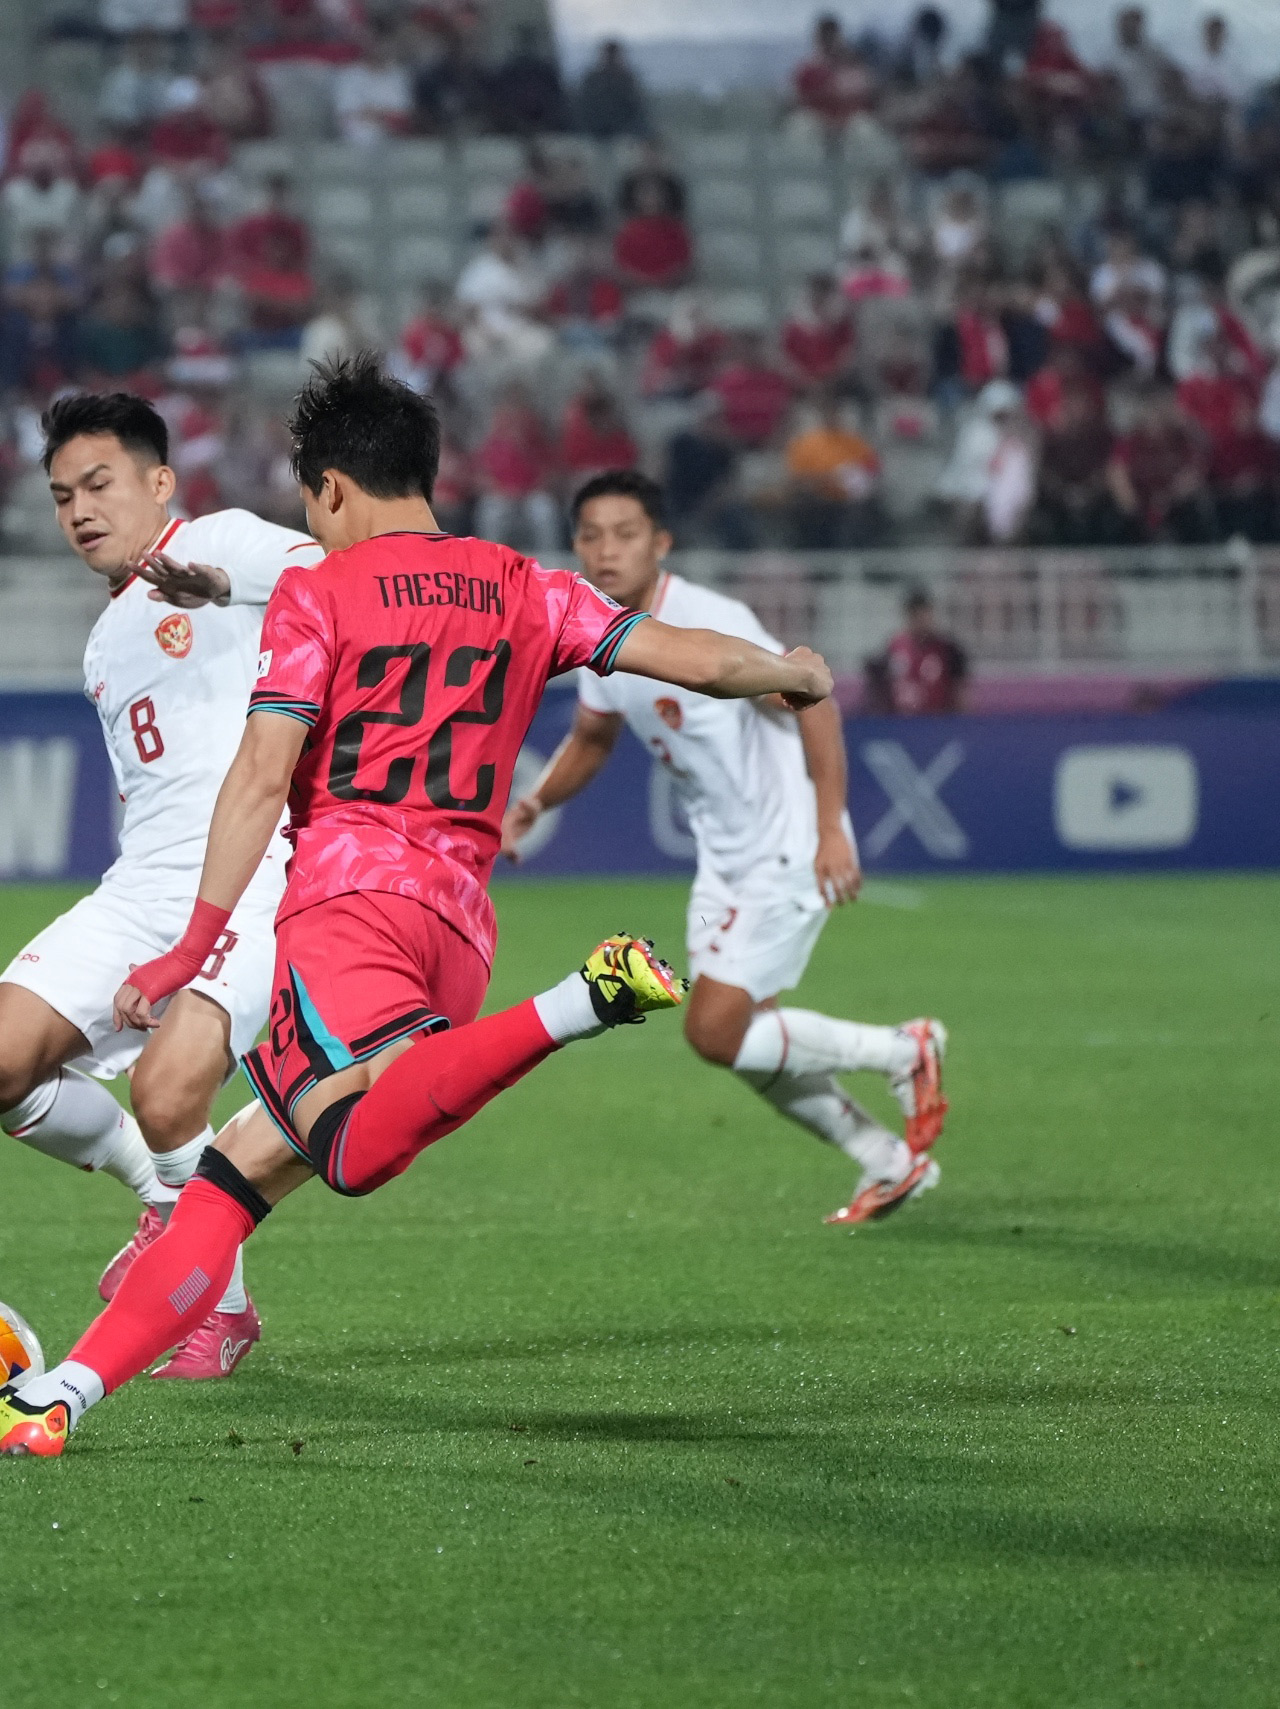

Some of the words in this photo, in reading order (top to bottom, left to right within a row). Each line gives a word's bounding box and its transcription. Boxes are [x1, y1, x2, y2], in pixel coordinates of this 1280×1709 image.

[373, 572, 502, 616] TAESEOK
[129, 695, 165, 764] 8
[327, 639, 512, 812] 22
[198, 928, 240, 981] 8
